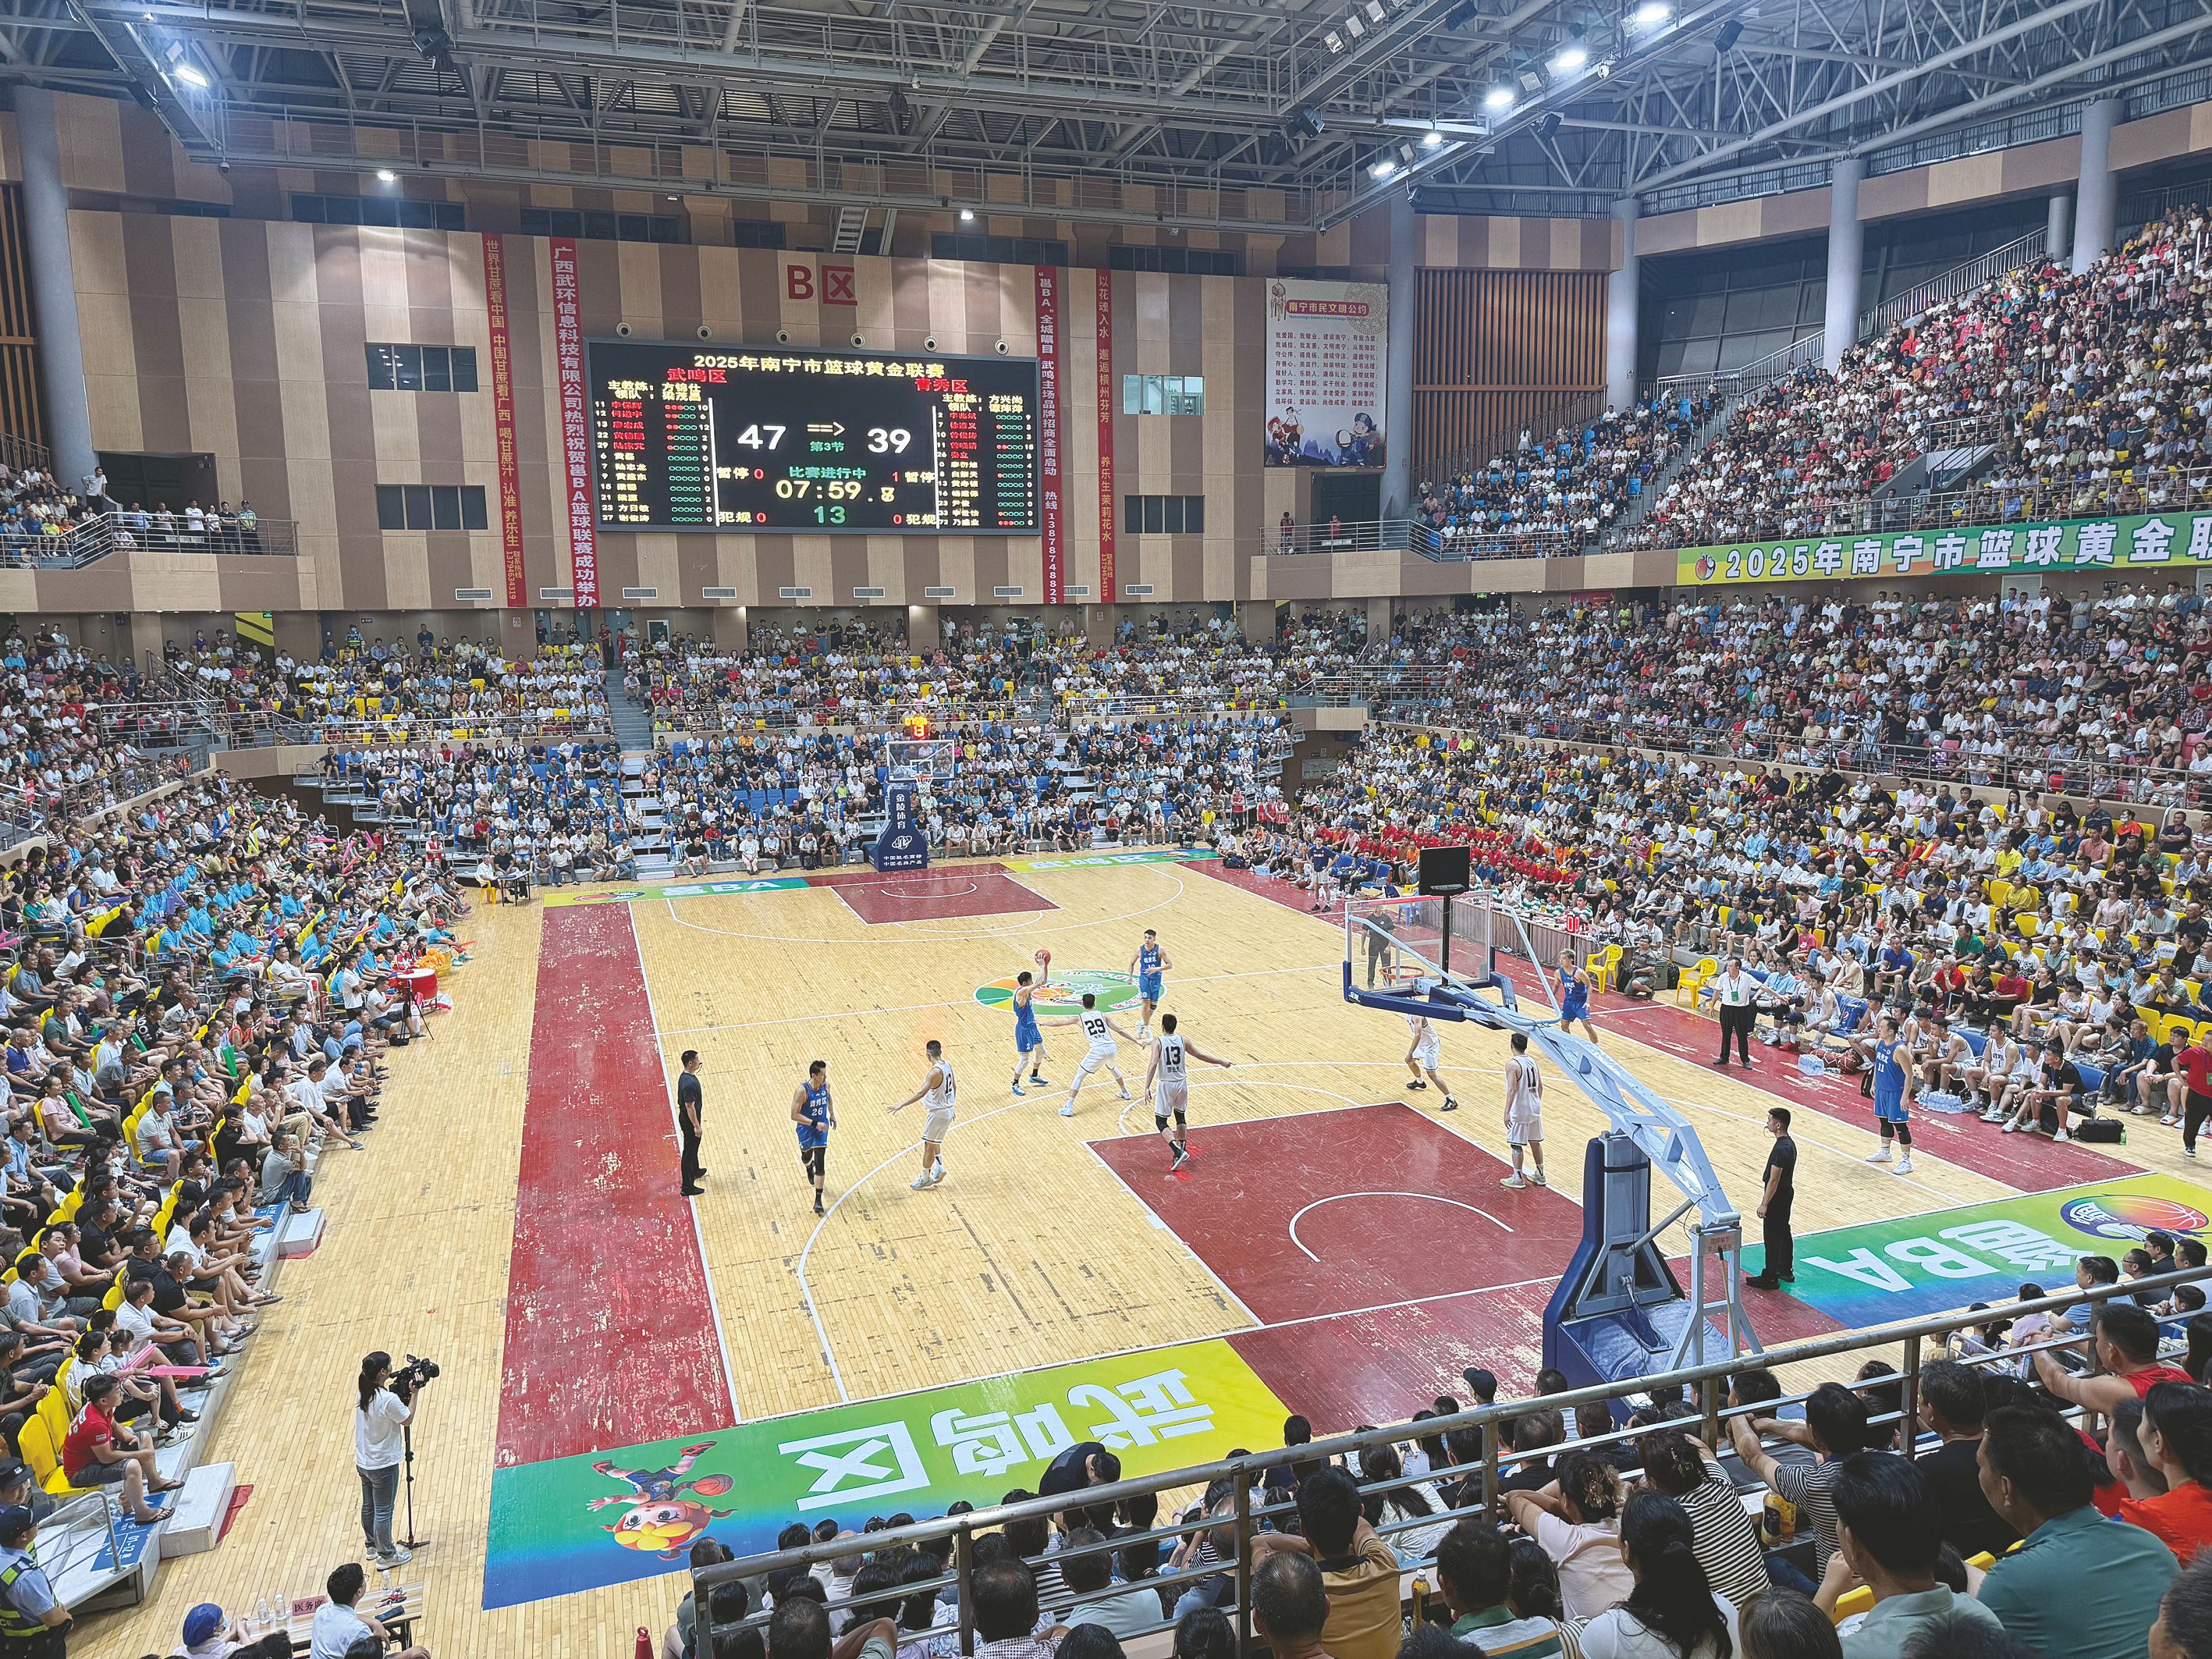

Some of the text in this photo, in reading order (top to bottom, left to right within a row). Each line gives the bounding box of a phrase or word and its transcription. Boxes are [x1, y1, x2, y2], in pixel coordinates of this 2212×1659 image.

[787, 265, 857, 306] B区
[1099, 275, 1110, 339] 以花魂入水
[1289, 303, 1367, 314] 南宁市民文明公约
[694, 355, 945, 378] 2025年南宁市篮球黄金联赛
[667, 368, 727, 384] 武鸣区
[914, 378, 968, 392] 青秀区
[487, 240, 520, 546] 世界甘蔗看中国 中国甘蔗看广西 喝甘蔗汁 认准 养乐生
[1041, 361, 1056, 476] 武鸣主场品牌招商全面启动
[737, 425, 786, 449] 47
[868, 428, 911, 454] 39
[810, 441, 844, 453] 第3节
[717, 467, 765, 480] 暂停 0
[790, 467, 866, 479] 比赛进行中
[893, 471, 936, 484] 1 暂停
[719, 511, 766, 524] 犯规 0
[813, 506, 846, 524] 13
[893, 513, 936, 526] 0 犯规
[896, 794, 906, 829] 金陵体育
[1085, 1018, 1106, 1036] 29
[1166, 1046, 1181, 1065] 13
[1526, 1066, 1536, 1088] 11
[811, 1107, 823, 1116] 26
[779, 1368, 1215, 1512] 武鸣区
